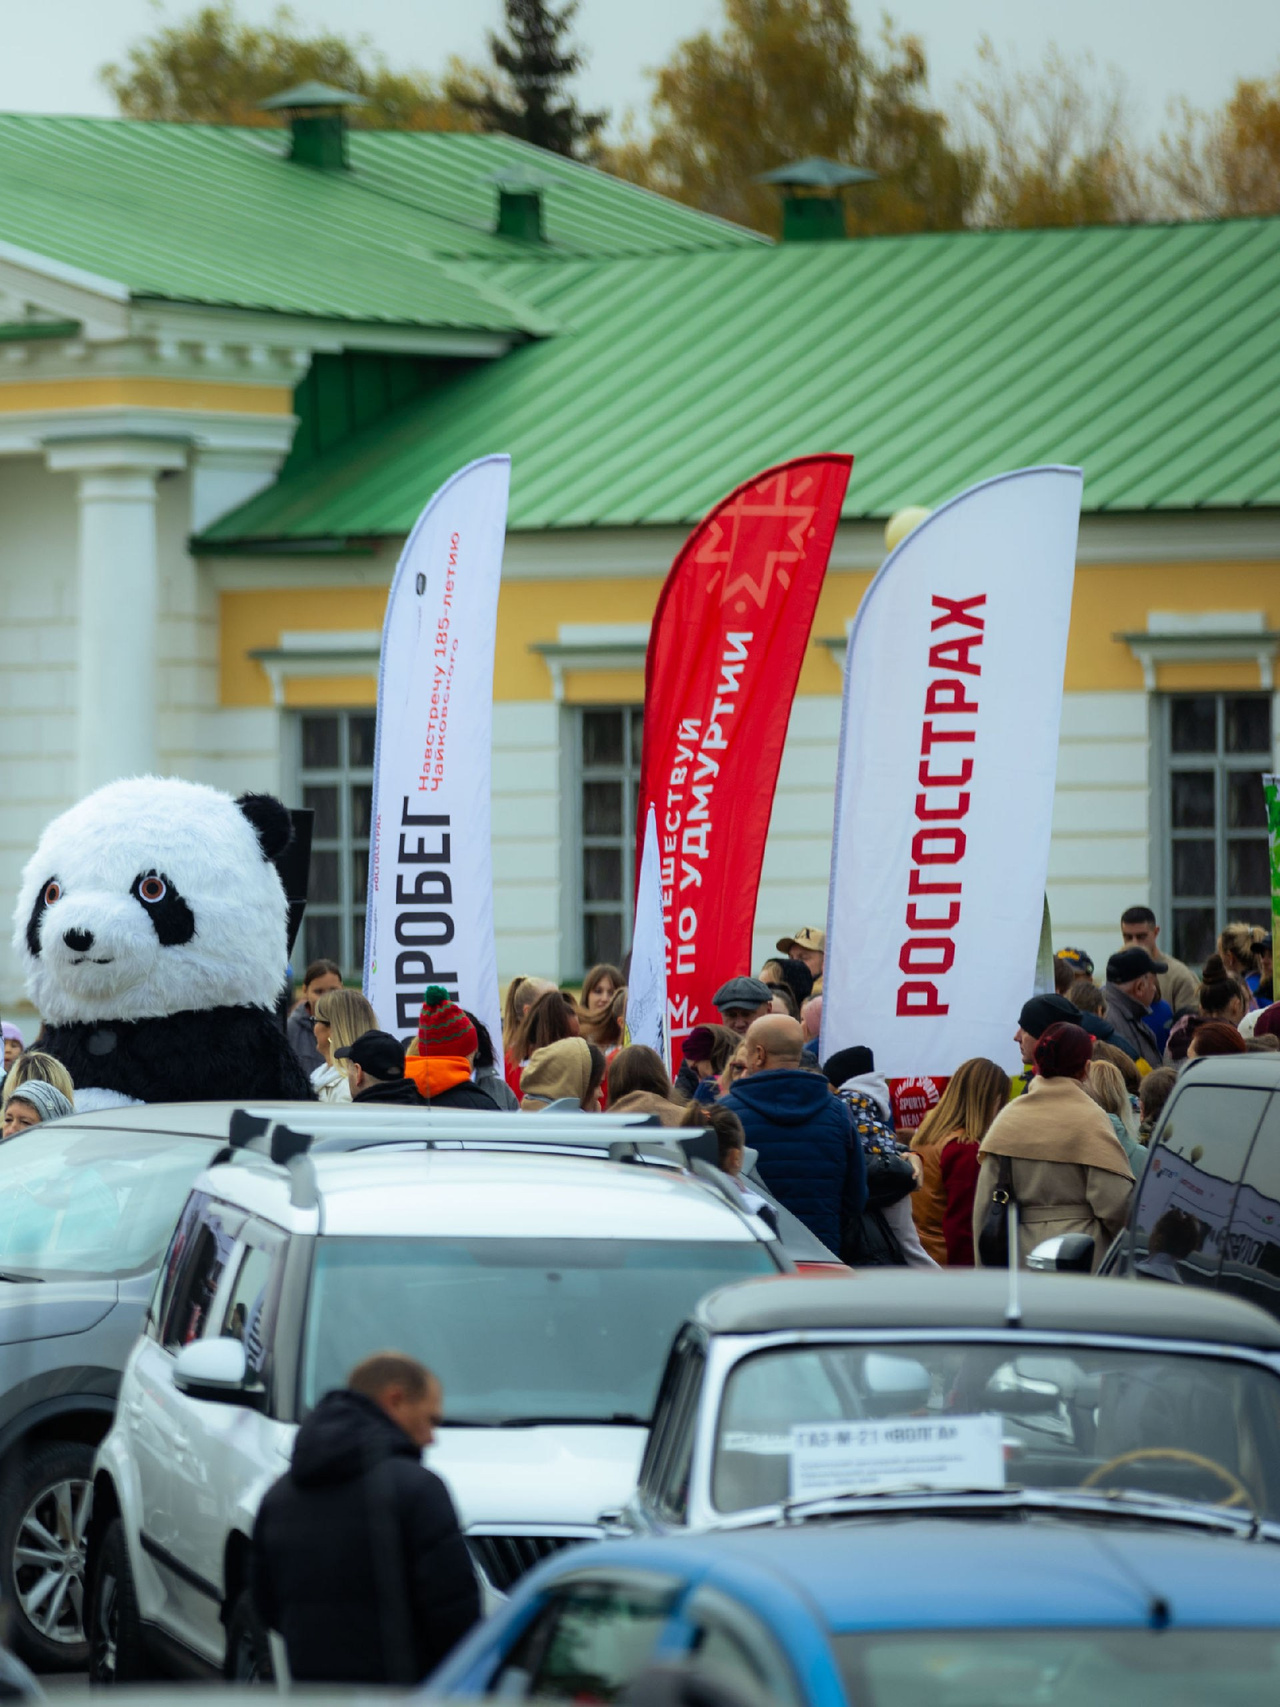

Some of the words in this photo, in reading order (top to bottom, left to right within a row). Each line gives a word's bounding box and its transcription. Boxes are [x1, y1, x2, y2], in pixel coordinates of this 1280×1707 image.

[418, 664, 446, 791] Навстречу
[434, 532, 460, 657] 185-летию
[679, 632, 754, 891] УДМУРТИИ
[394, 796, 460, 1046] ПРОБЕГ
[896, 594, 986, 1017] РОСГОССТРАХ
[676, 906, 698, 975] ПО
